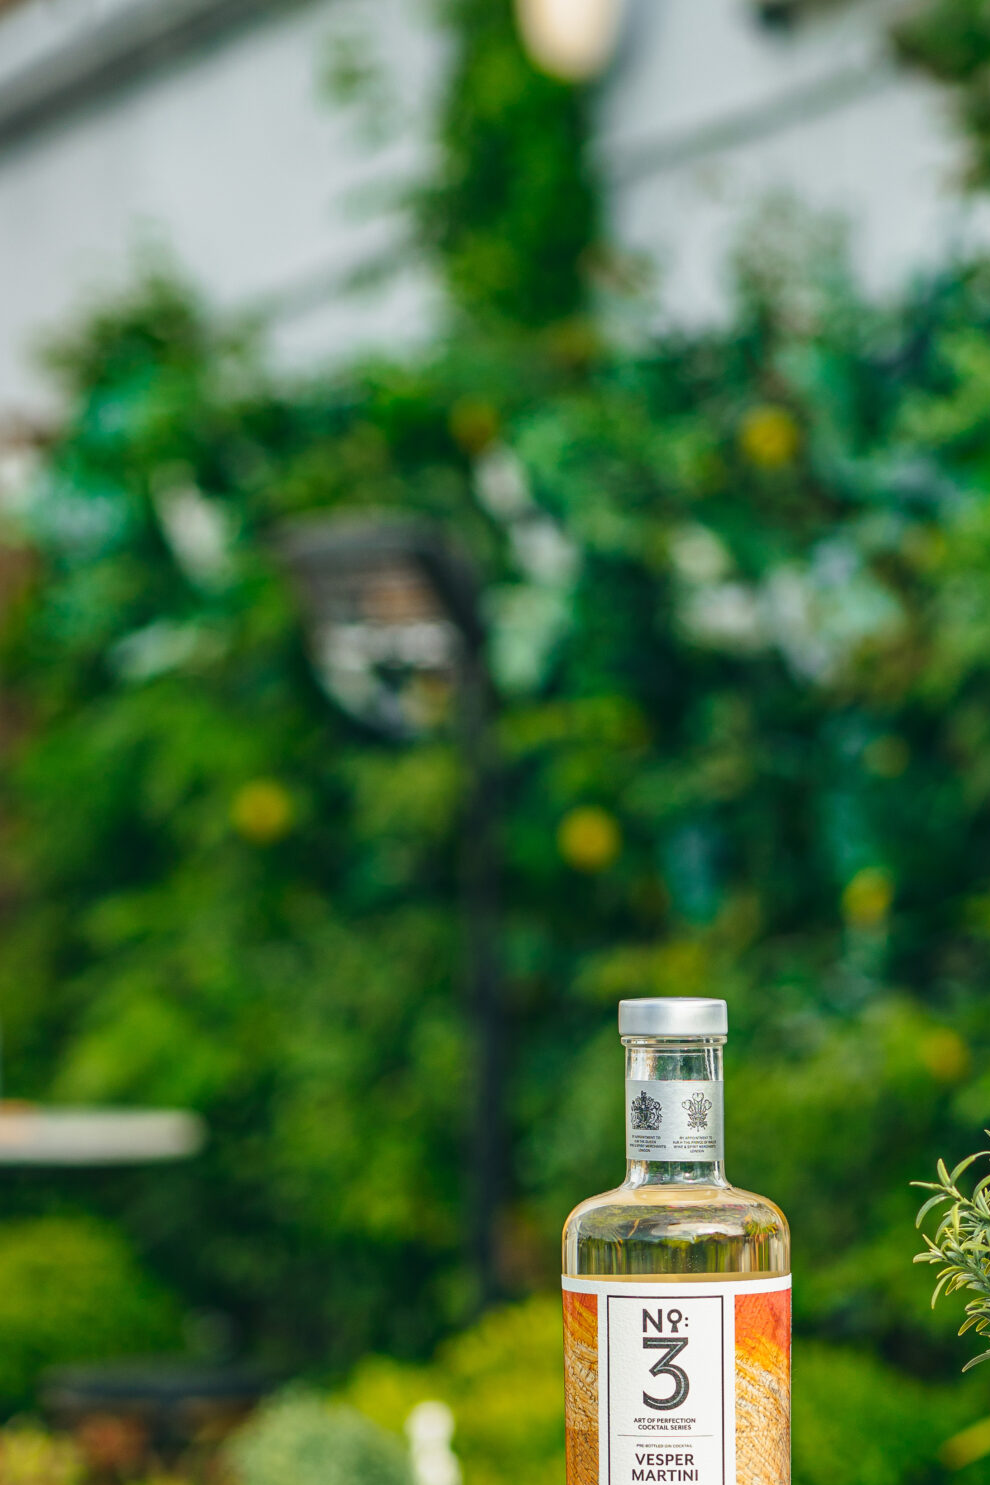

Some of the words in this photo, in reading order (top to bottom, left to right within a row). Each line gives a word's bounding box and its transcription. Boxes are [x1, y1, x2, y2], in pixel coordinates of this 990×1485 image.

[642, 1337, 690, 1411] 3
[634, 1453, 694, 1466] VESPER
[632, 1469, 698, 1482] MARTINI
